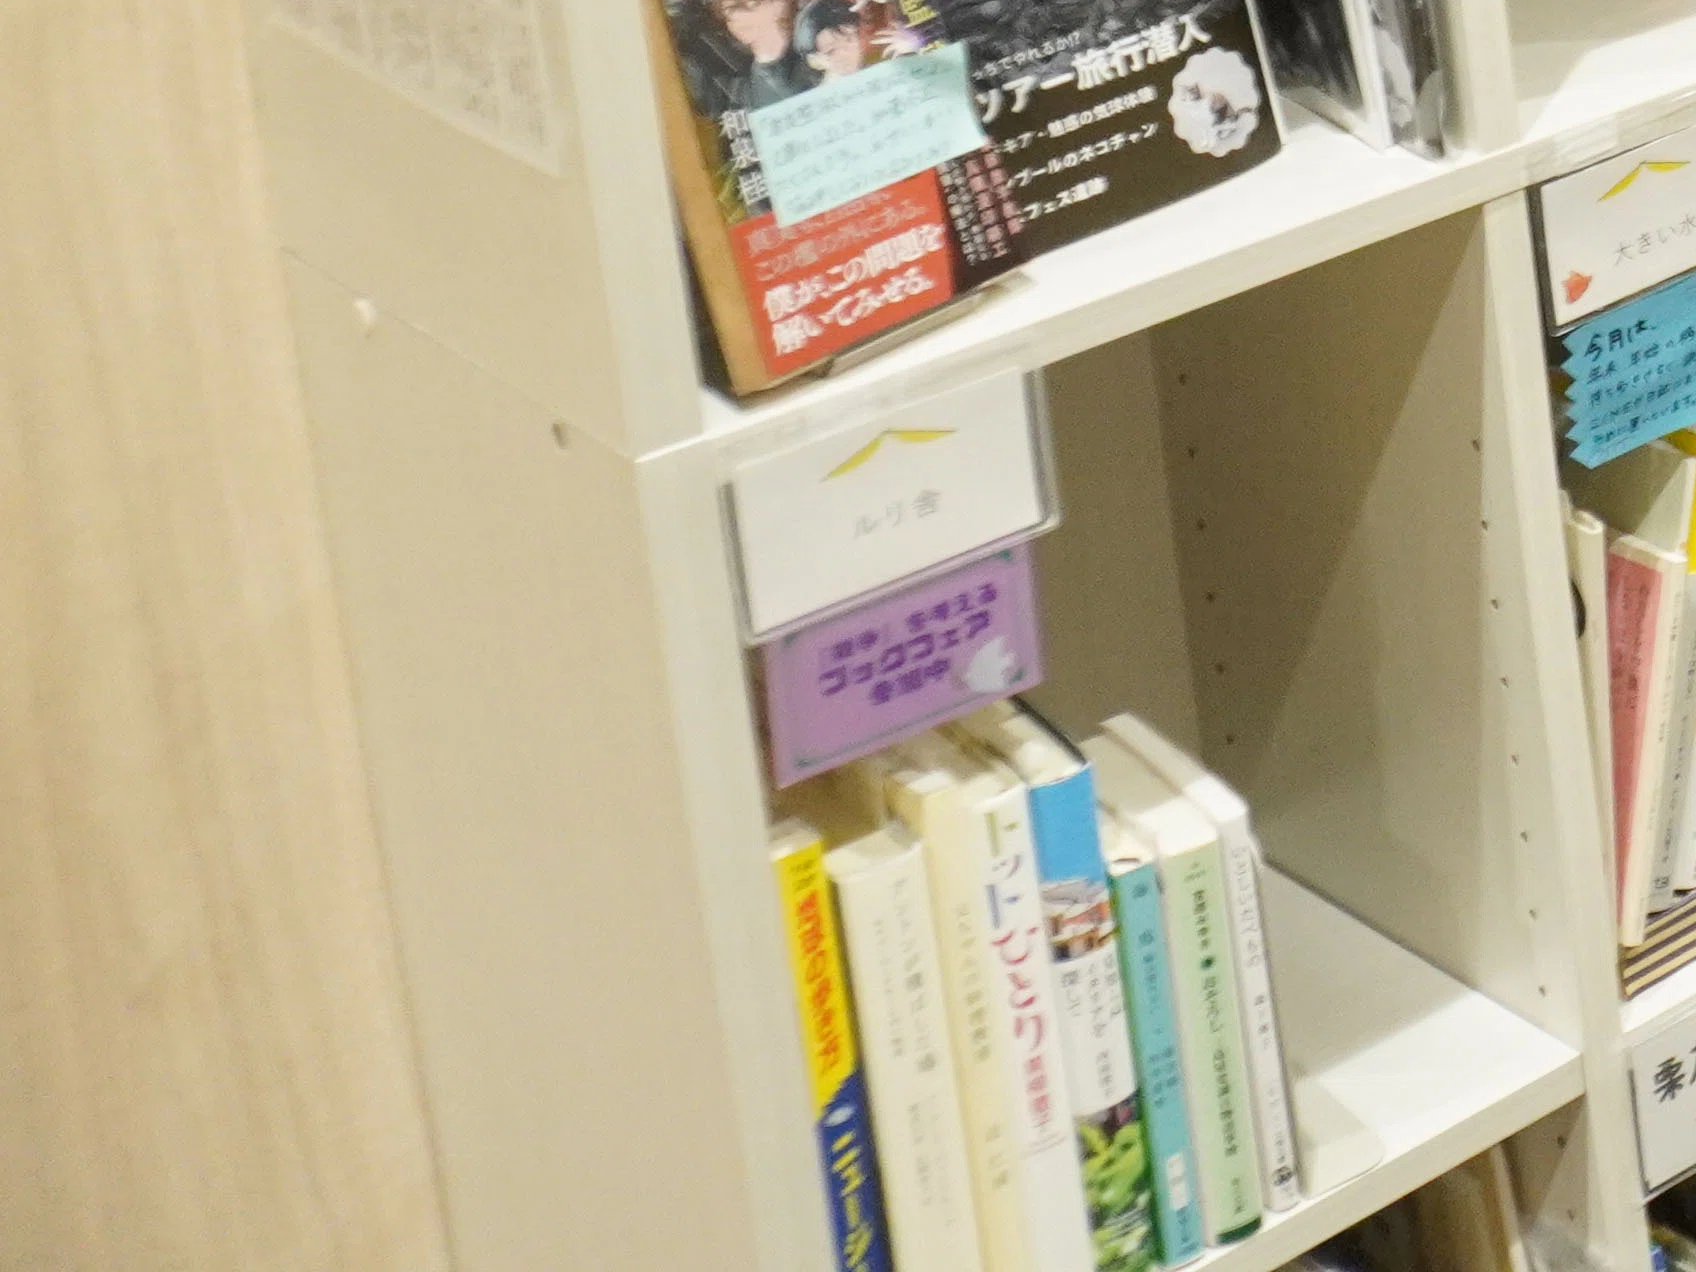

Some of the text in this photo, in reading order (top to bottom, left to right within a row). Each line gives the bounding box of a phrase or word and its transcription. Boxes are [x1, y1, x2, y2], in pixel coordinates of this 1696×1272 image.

[719, 107, 768, 206] 和泉桂
[851, 490, 942, 540] ルリ舎
[816, 608, 994, 698] ブックフェア
